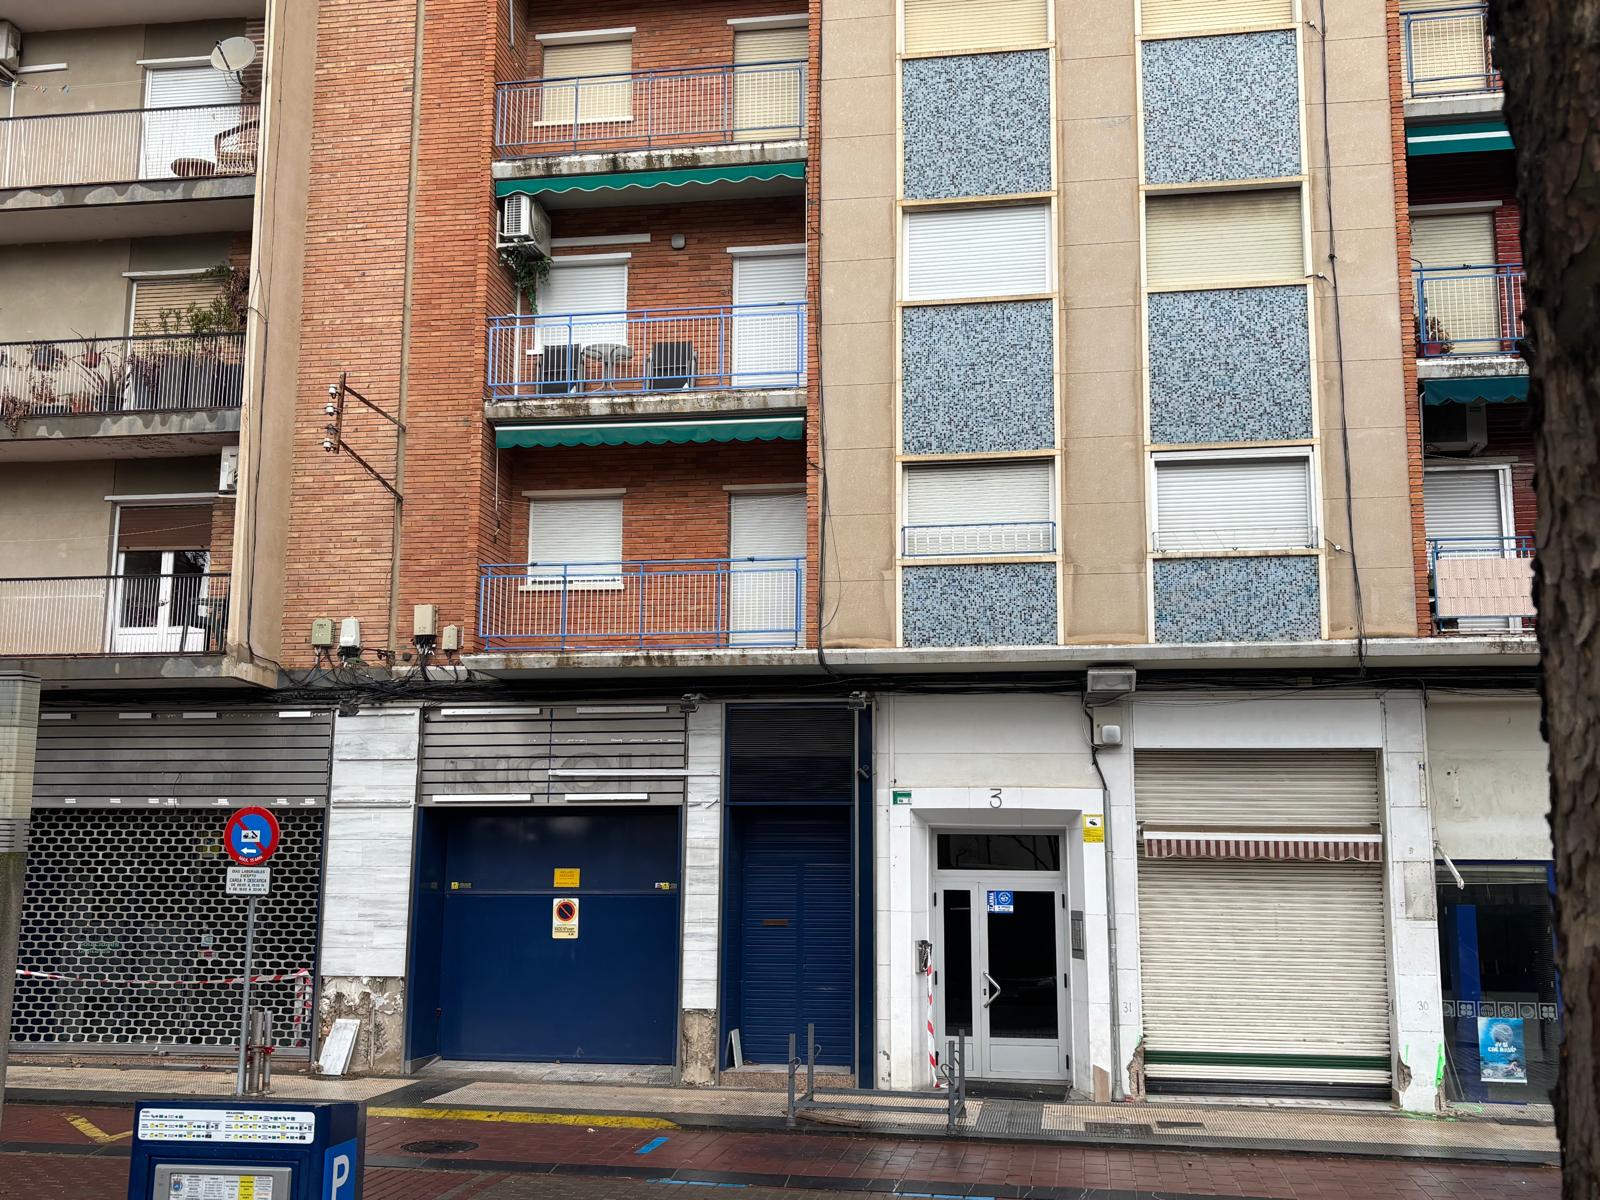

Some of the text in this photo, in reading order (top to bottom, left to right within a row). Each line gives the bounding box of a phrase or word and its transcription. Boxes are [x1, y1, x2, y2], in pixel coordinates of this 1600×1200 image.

[988, 788, 1002, 809] 3
[1416, 1000, 1429, 1011] 30
[331, 1154, 350, 1200] P
